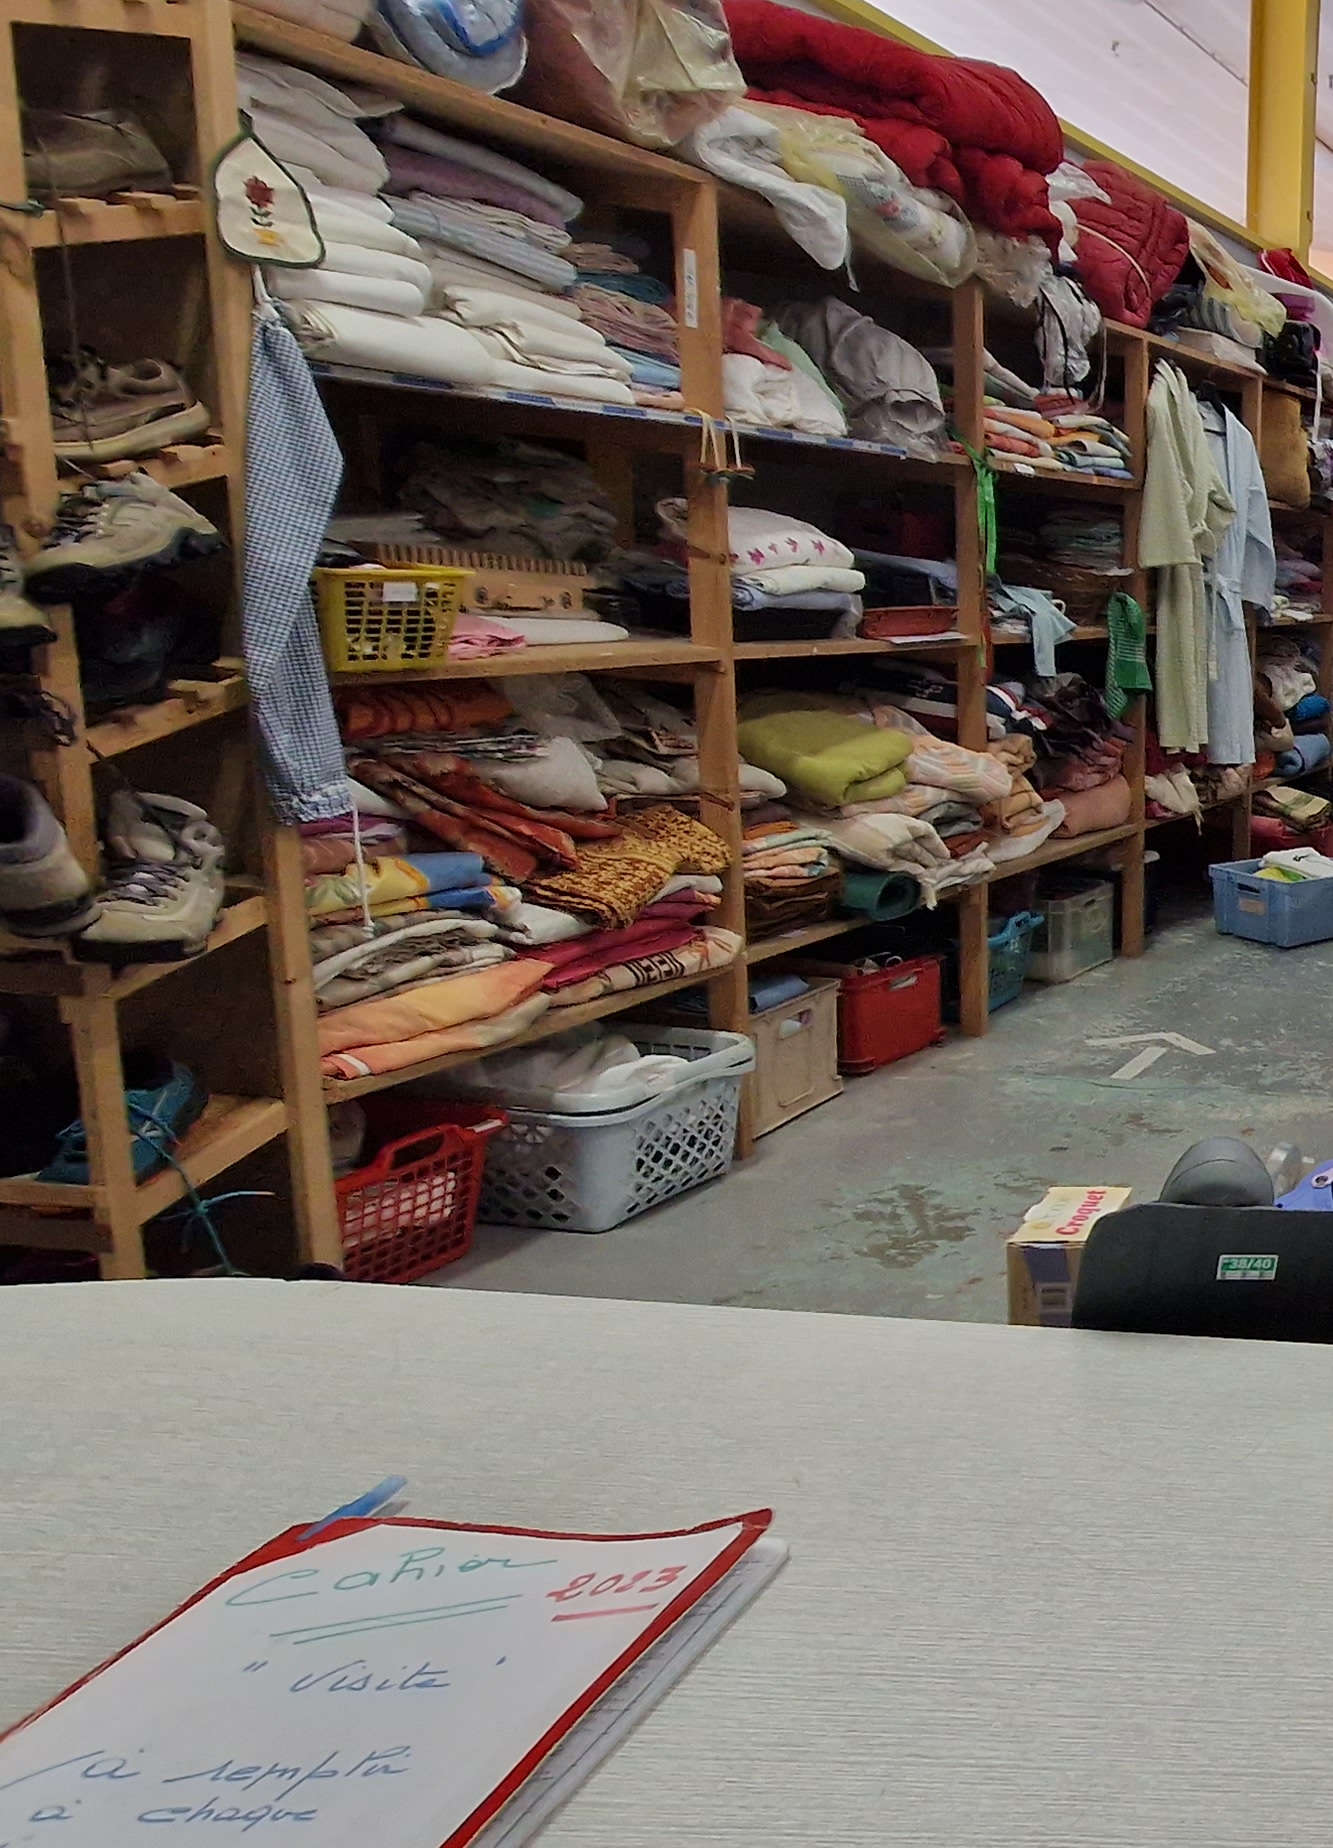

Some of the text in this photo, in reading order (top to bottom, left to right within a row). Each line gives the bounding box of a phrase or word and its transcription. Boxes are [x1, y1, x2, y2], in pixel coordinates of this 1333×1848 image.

[1056, 1190, 1107, 1235] Croquet
[1228, 1257, 1272, 1269] 38/40
[225, 1547, 688, 1606] Cahier 2023
[137, 1797, 318, 1833] chaque
